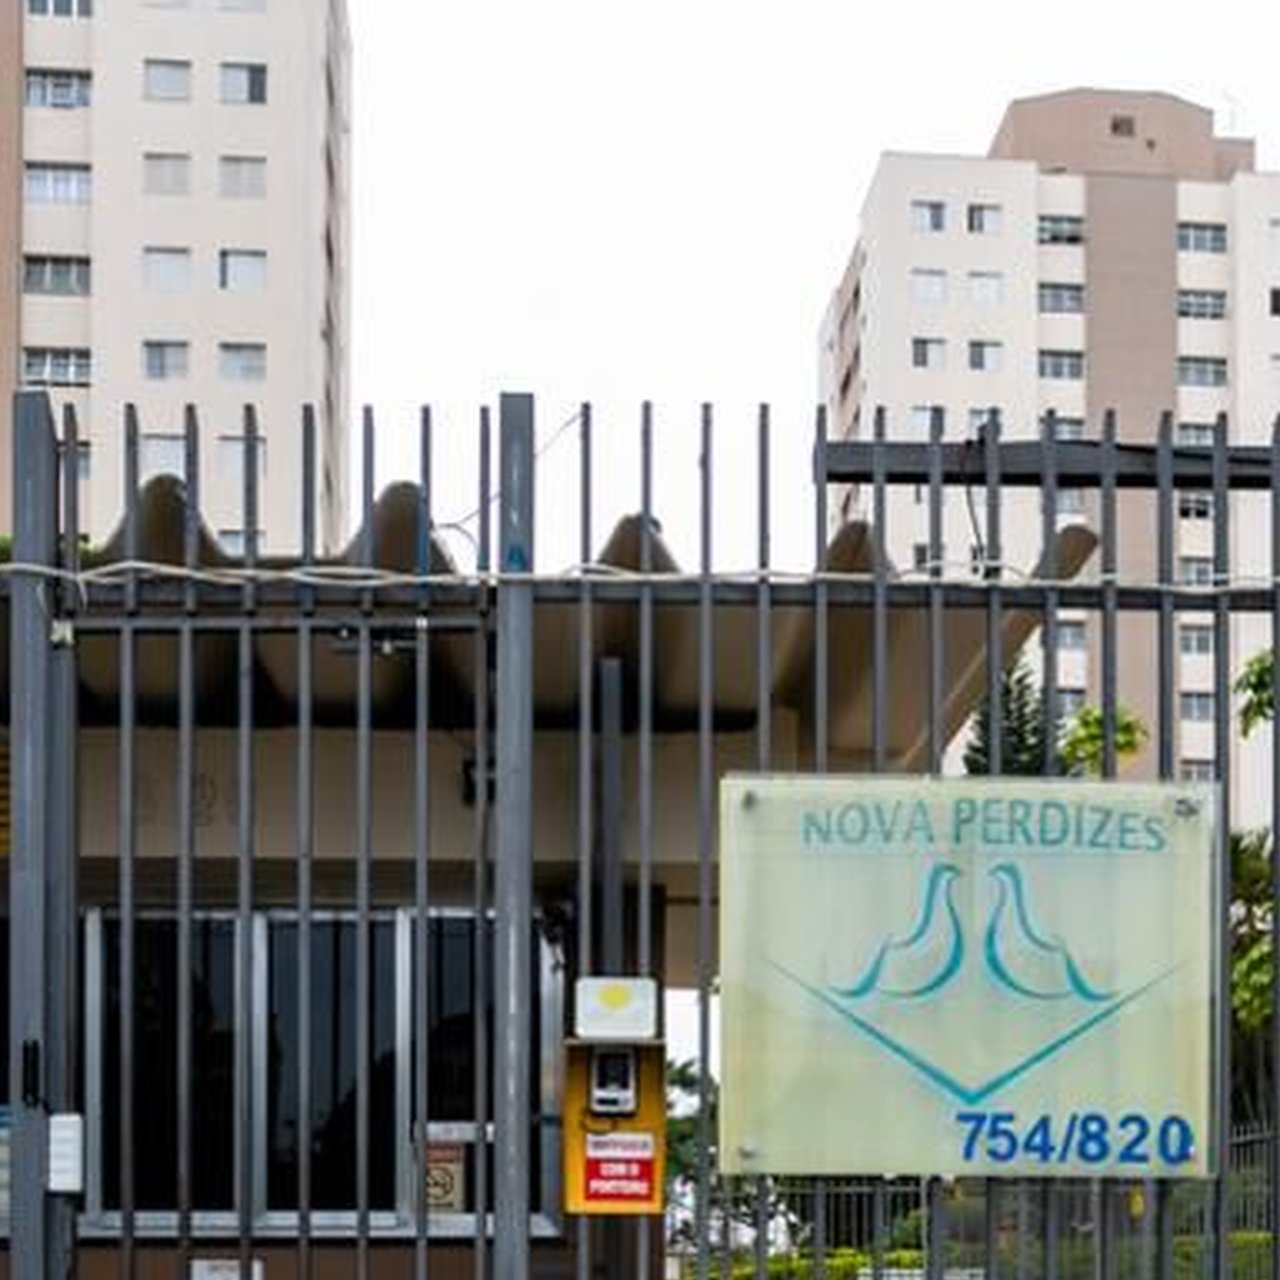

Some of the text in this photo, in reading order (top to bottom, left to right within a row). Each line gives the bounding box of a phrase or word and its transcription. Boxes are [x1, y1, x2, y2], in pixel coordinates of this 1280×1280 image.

[803, 798, 1168, 852] NOVA PERDIZES
[956, 1112, 1195, 1165] 754/820
